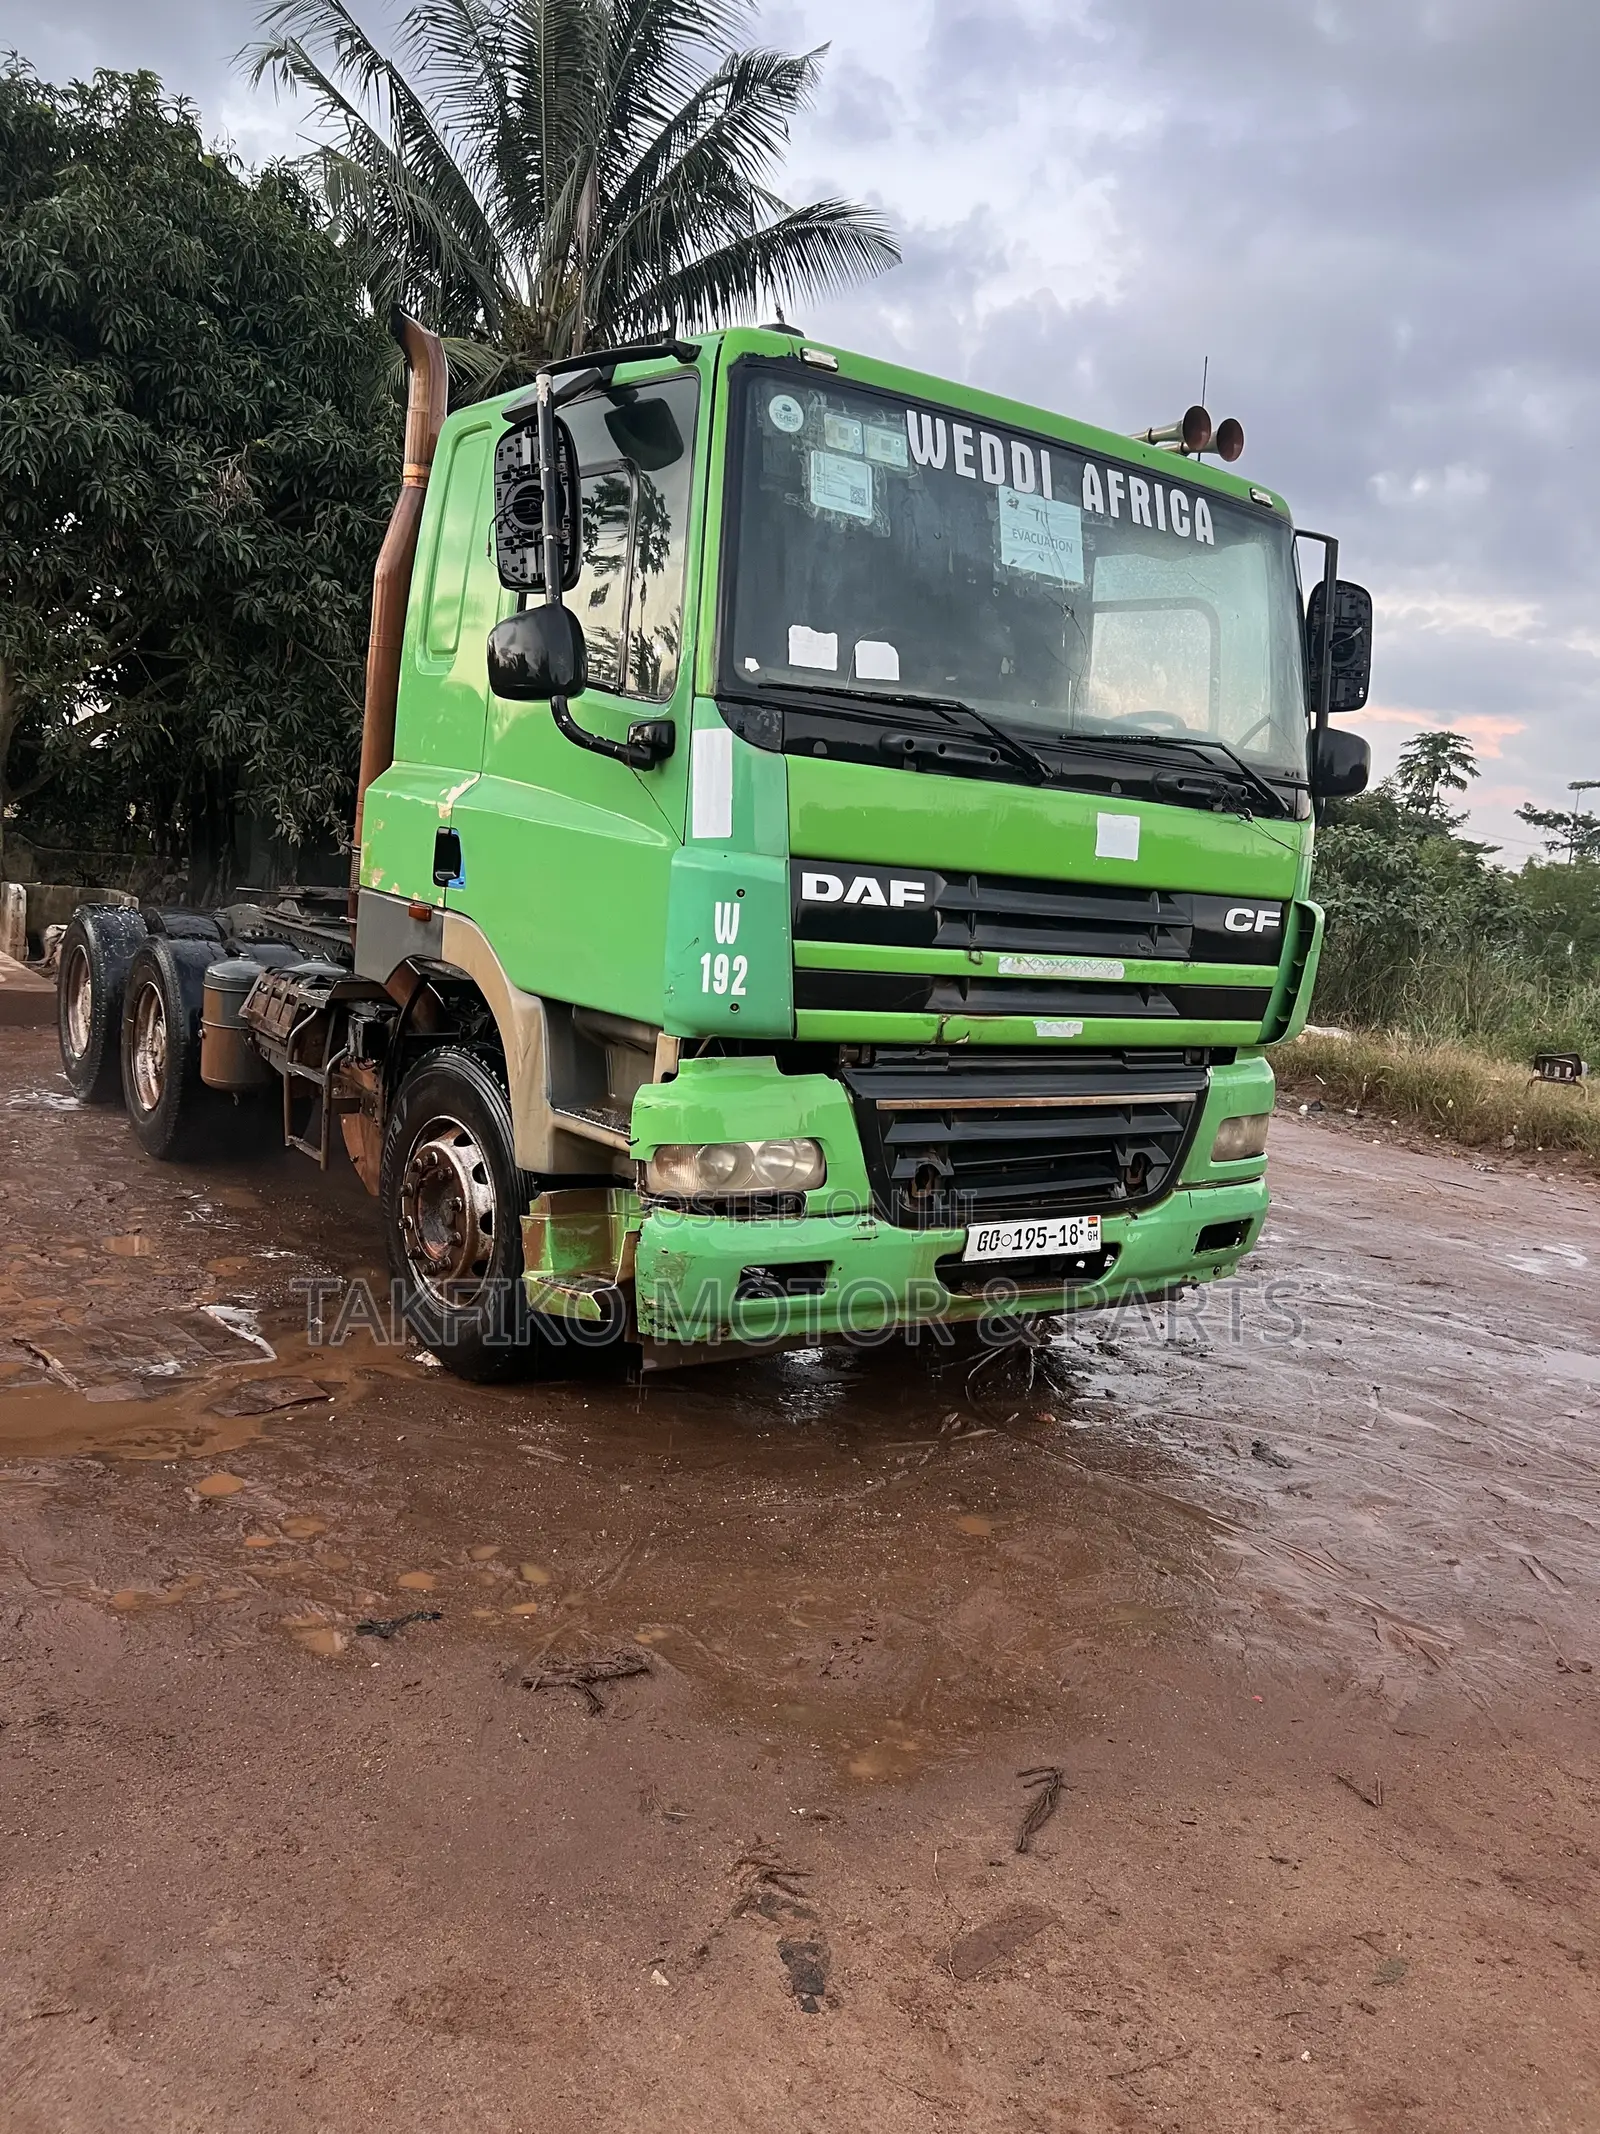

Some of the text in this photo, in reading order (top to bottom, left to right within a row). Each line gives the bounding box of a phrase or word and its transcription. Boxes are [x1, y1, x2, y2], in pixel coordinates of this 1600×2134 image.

[906, 409, 1053, 500] WEDDI
[1082, 463, 1215, 546] AFRICA
[1012, 528, 1073, 554] EVACUATION
[802, 872, 925, 907] DAF
[714, 901, 740, 945] W
[1224, 907, 1281, 932] CF
[700, 952, 748, 996] 192
[1011, 1223, 1079, 1251] 195-18
[1087, 1230, 1099, 1242] GH
